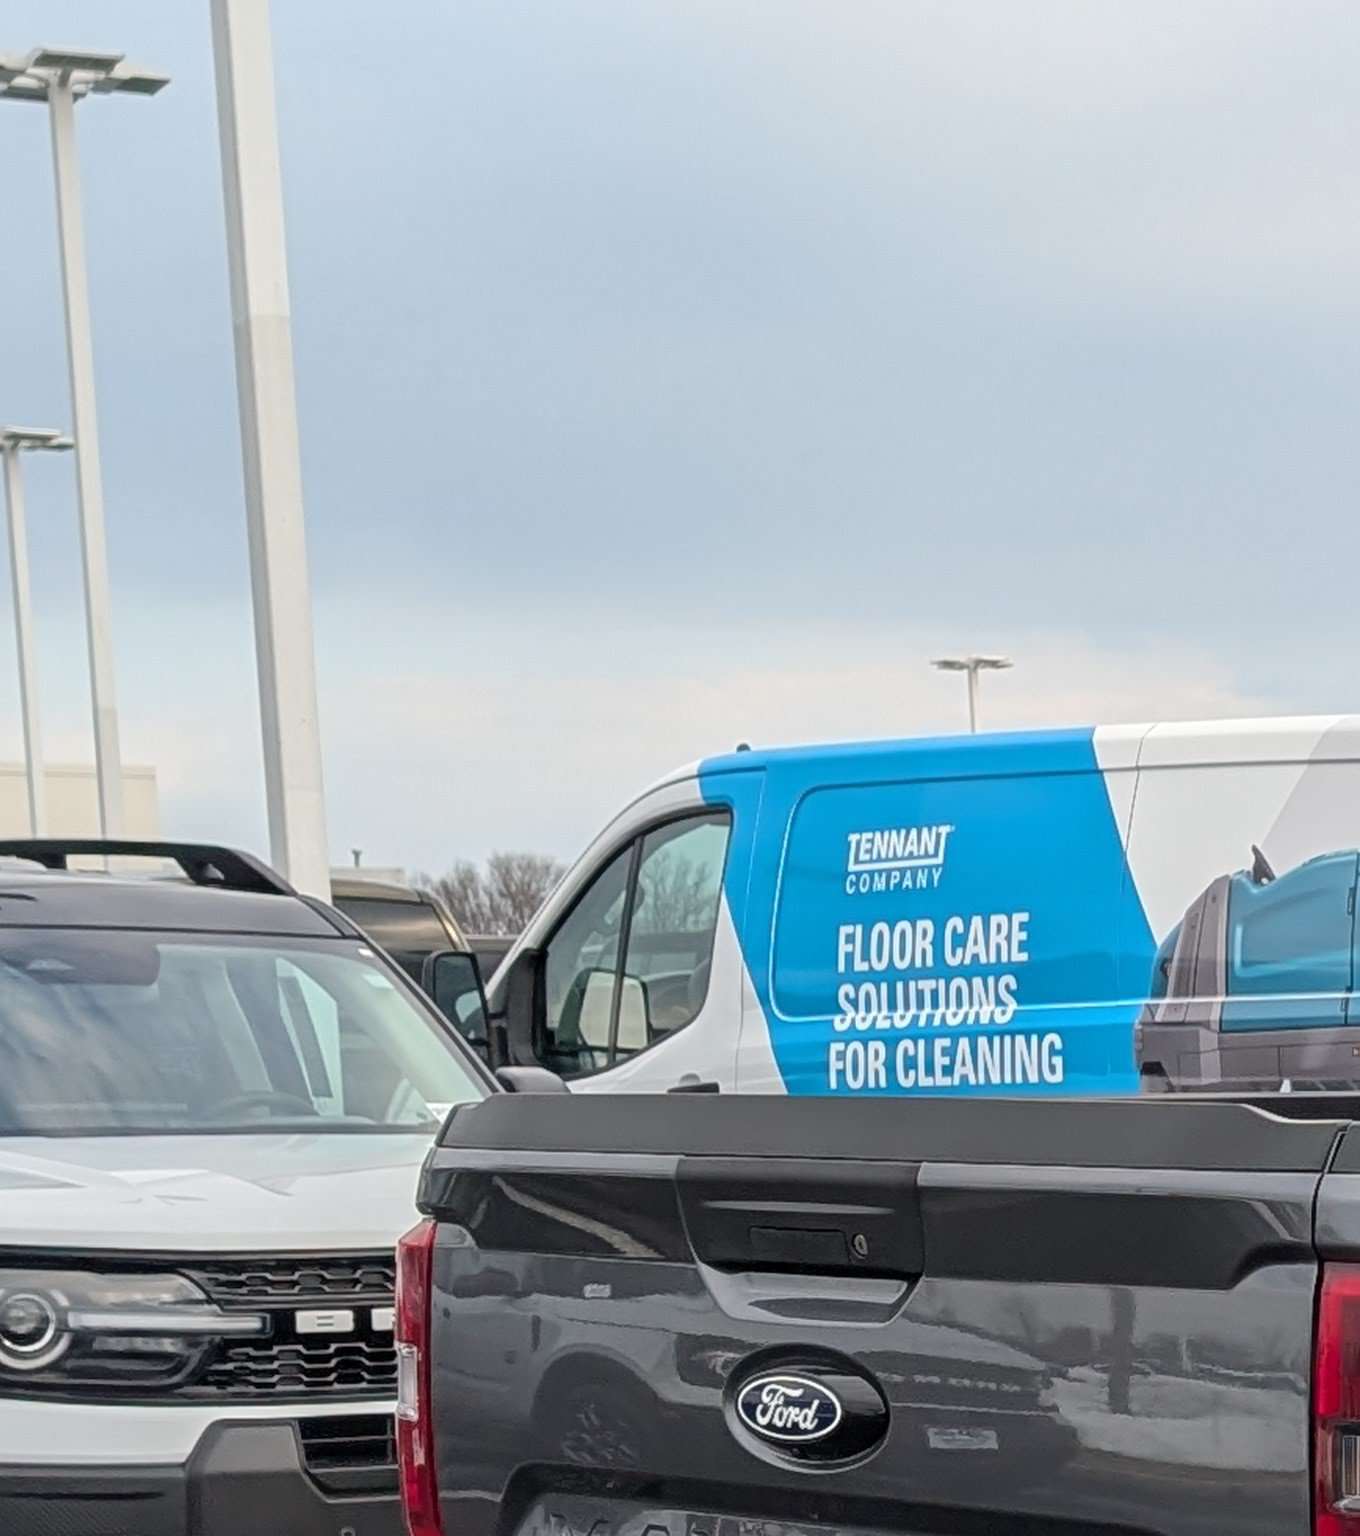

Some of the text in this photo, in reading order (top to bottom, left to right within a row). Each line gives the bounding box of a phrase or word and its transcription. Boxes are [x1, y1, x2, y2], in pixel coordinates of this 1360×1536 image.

[847, 825, 951, 872] TENNANT
[845, 866, 943, 895] COMPANY
[837, 911, 1030, 974] FLOOR CARE
[833, 974, 1018, 1032] SOLUTIONS
[829, 1032, 1064, 1090] FOR CLEANING
[755, 1383, 820, 1430] Ford
